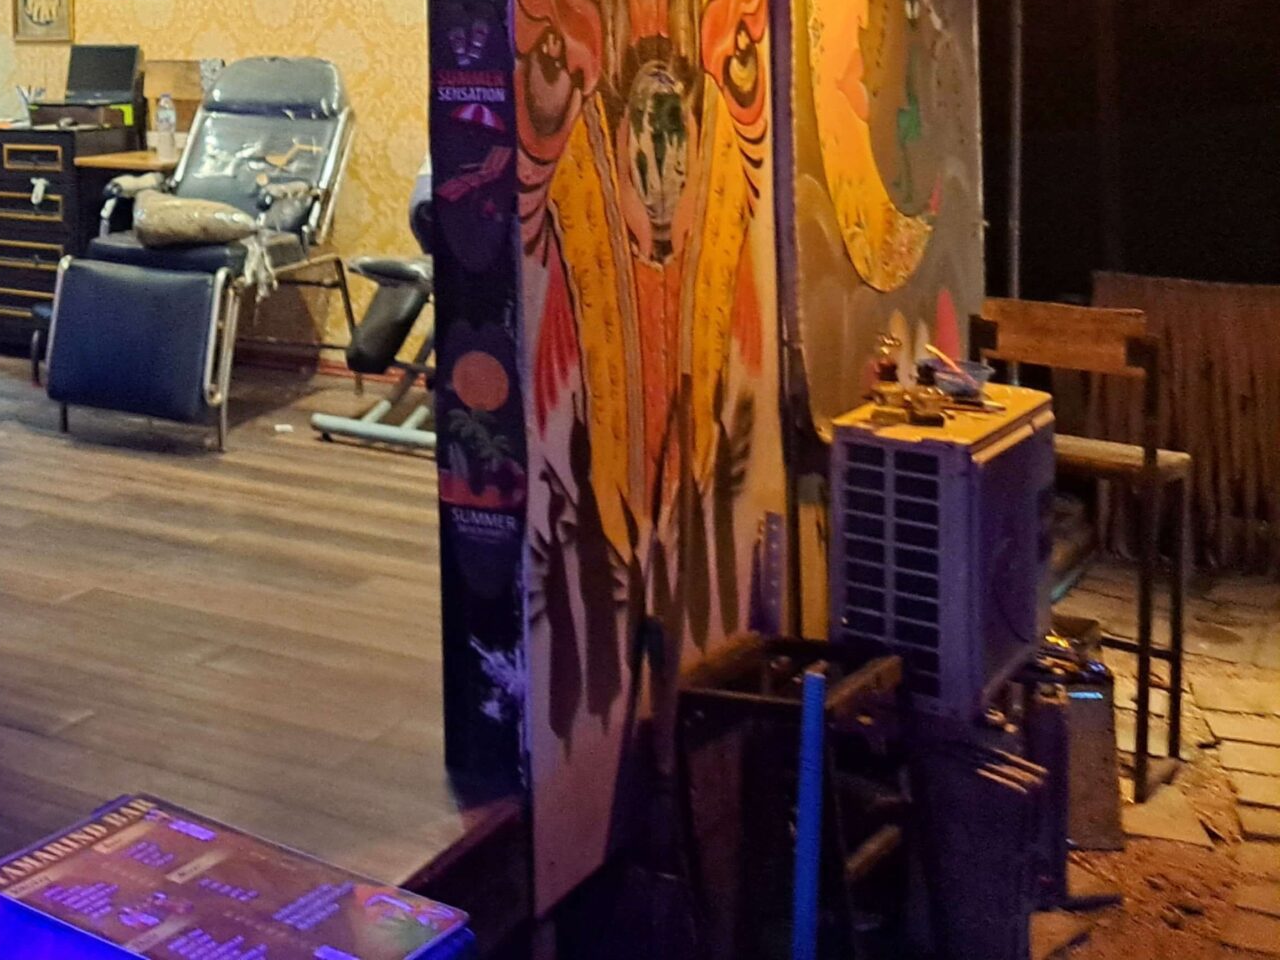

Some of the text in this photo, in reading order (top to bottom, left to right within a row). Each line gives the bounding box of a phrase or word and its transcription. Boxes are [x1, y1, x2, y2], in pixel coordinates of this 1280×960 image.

[437, 86, 505, 102] SENSATION
[451, 507, 519, 530] SUMMER
[102, 798, 157, 825] BAR
